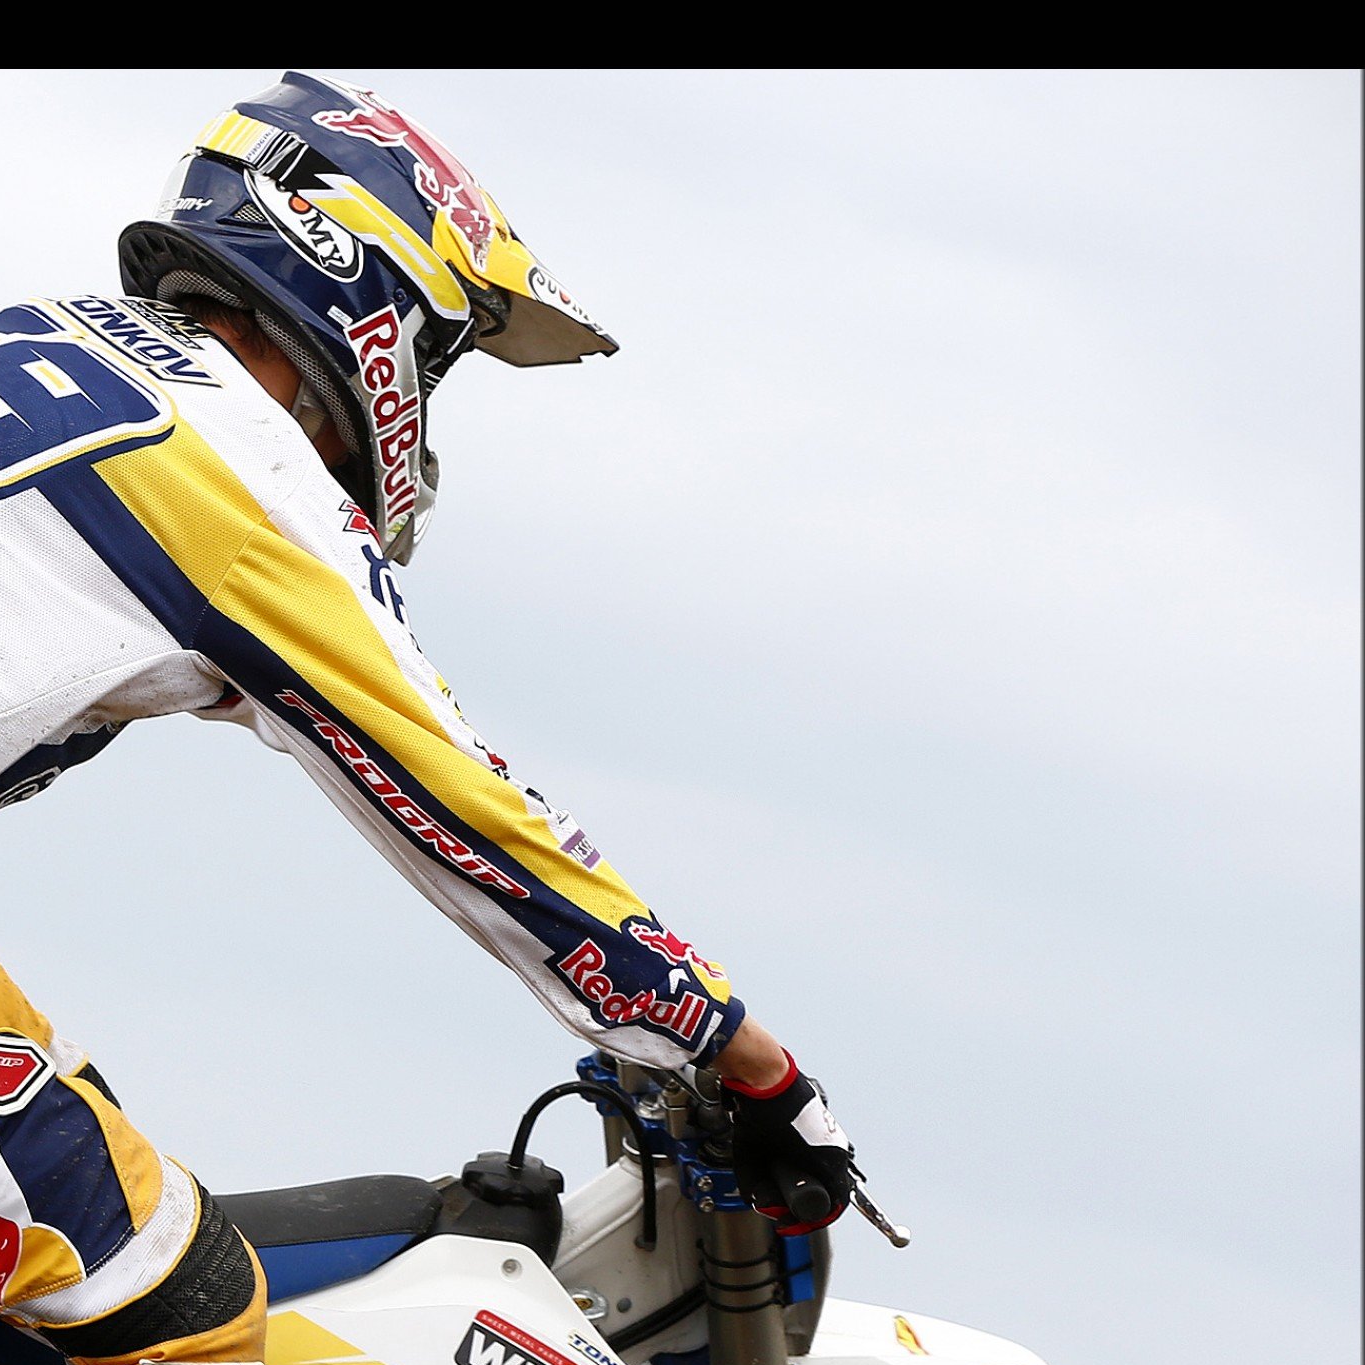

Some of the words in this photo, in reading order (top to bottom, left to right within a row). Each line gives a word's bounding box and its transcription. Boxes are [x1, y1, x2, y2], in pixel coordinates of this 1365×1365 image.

[69, 296, 212, 379] ONKOV
[510, 1329, 536, 1349] METAL
[538, 1344, 565, 1365] PARTS
